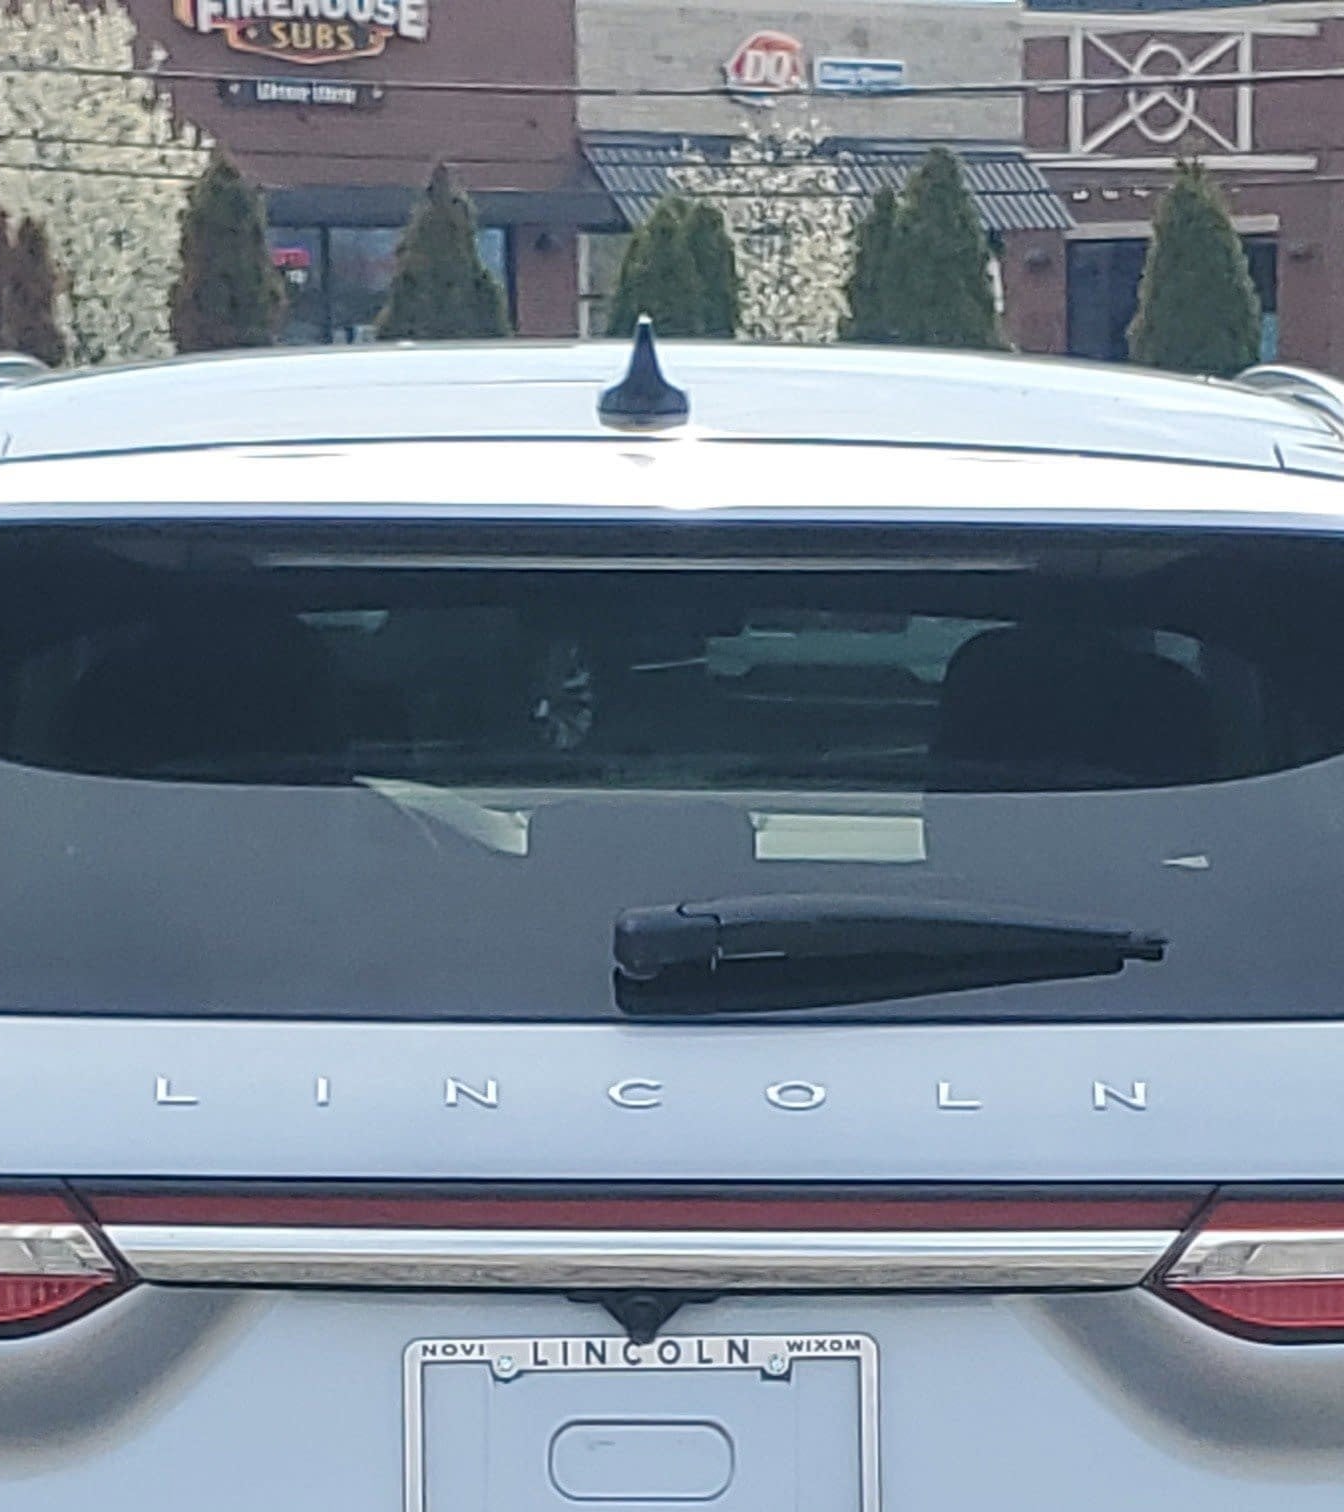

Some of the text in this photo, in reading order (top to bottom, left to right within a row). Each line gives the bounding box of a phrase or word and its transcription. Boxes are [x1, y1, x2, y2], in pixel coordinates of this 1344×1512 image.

[270, 21, 355, 50] SUBS
[154, 1075, 1148, 1110] LINCOLN
[421, 1343, 485, 1357] NOVI
[532, 1339, 750, 1367] LINCOLN
[786, 1339, 862, 1353] WIXOM
